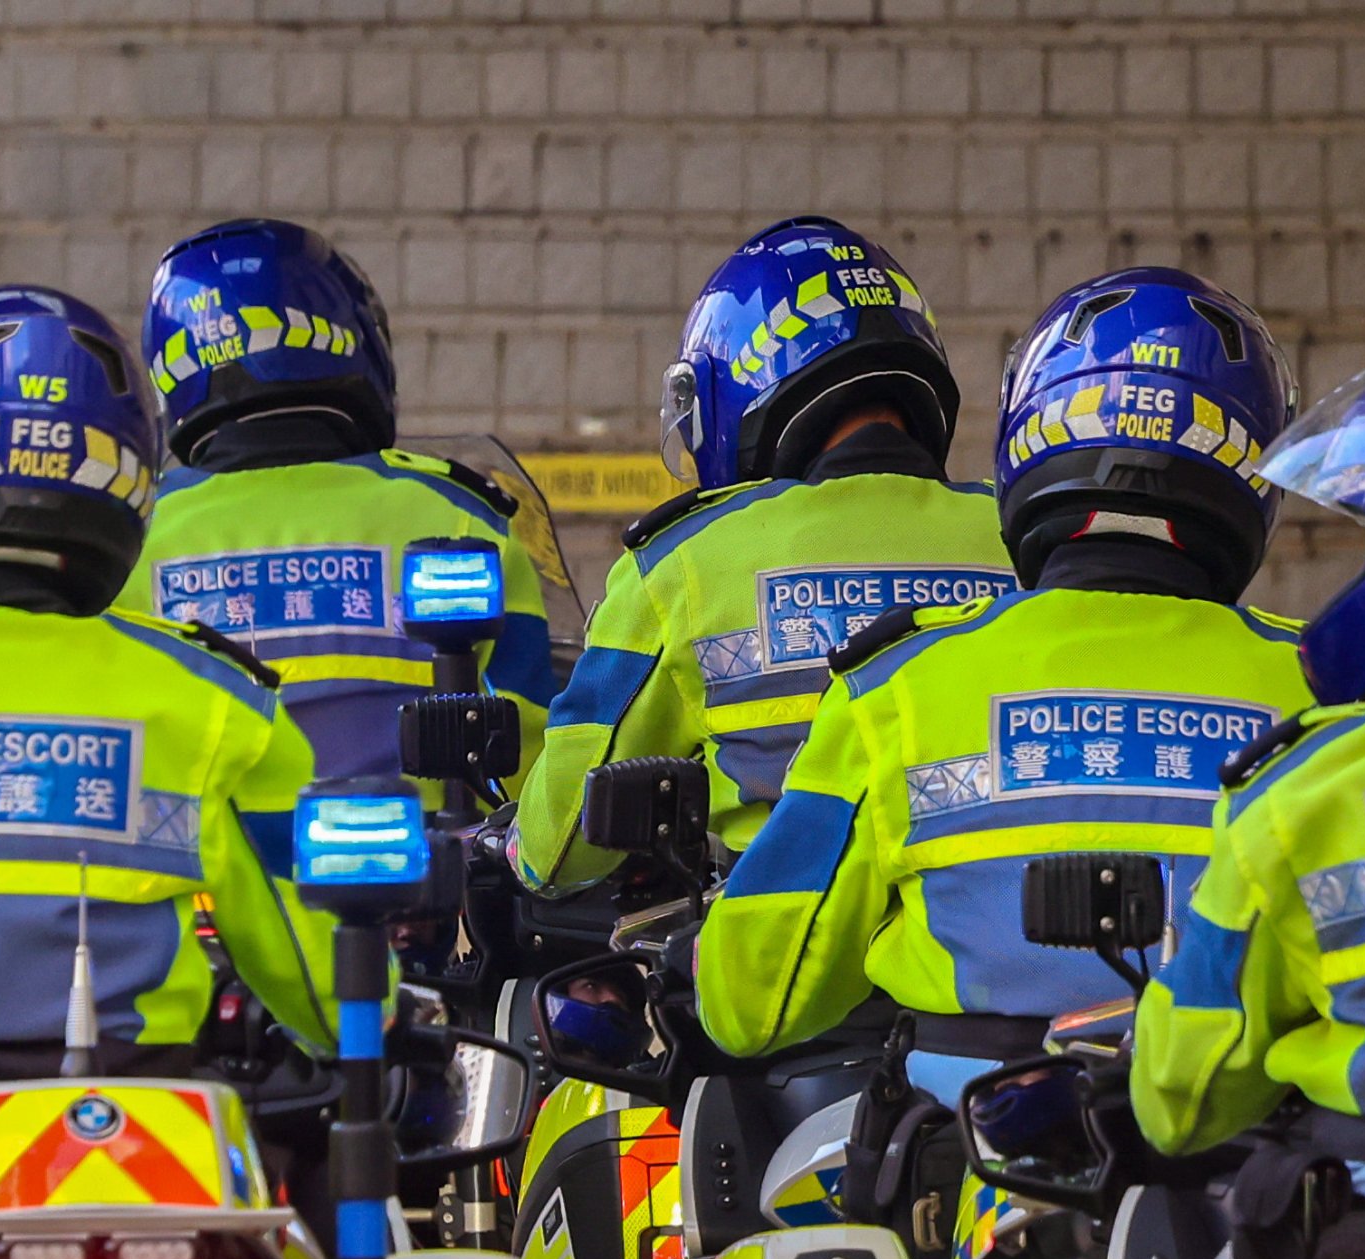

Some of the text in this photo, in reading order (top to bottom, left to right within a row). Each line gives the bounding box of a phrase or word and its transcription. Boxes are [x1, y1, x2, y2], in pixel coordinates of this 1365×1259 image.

[826, 245, 865, 261] W3
[836, 267, 886, 287] FEG
[188, 287, 222, 314] W1
[845, 286, 896, 308] POLICE
[191, 313, 238, 346] FEG
[197, 334, 245, 369] POLICE
[1131, 342, 1181, 369] W11
[18, 374, 69, 403] W5
[1119, 385, 1175, 413] FEG
[11, 418, 73, 449] FEG
[1116, 412, 1174, 442] POLICE
[8, 448, 72, 480] POLICE
[168, 555, 374, 594] POLICE ESCORT
[774, 578, 1010, 611] POLICE ESCORT
[1009, 704, 1264, 742] POLICE ESCORT
